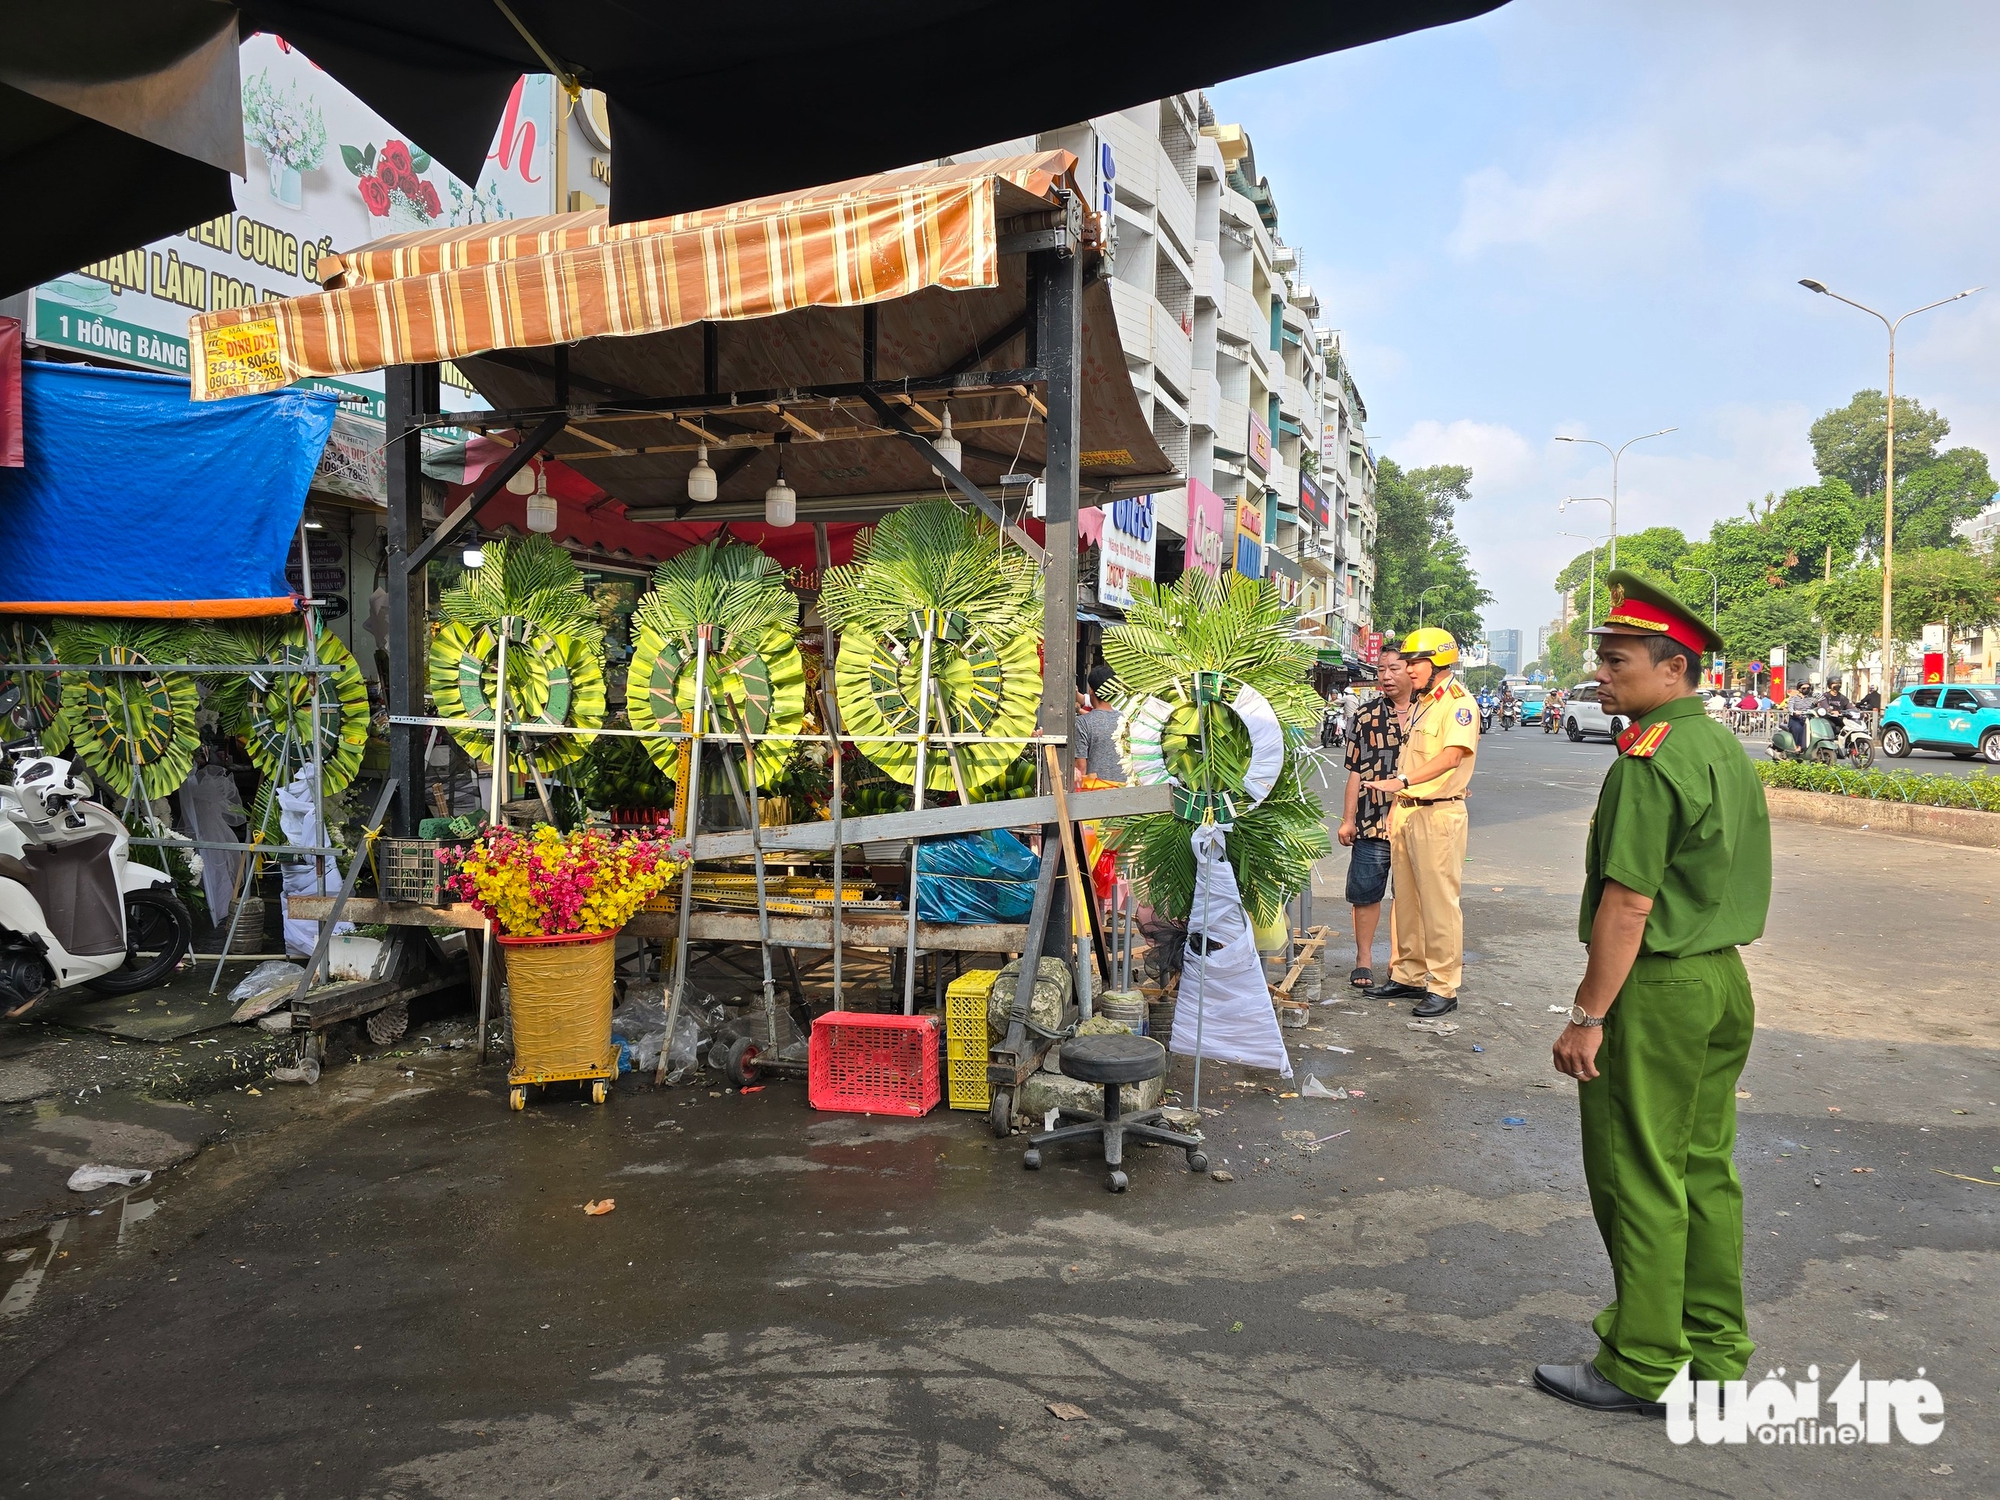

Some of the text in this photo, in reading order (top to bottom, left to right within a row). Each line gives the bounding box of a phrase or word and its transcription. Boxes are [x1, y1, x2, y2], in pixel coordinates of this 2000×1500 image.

[237, 215, 298, 278] CUNG
[151, 248, 206, 312] LÀM
[59, 316, 188, 368] 1 HỒNG BÀNG
[209, 351, 277, 375] 38418045
[253, 332, 277, 351] DUY
